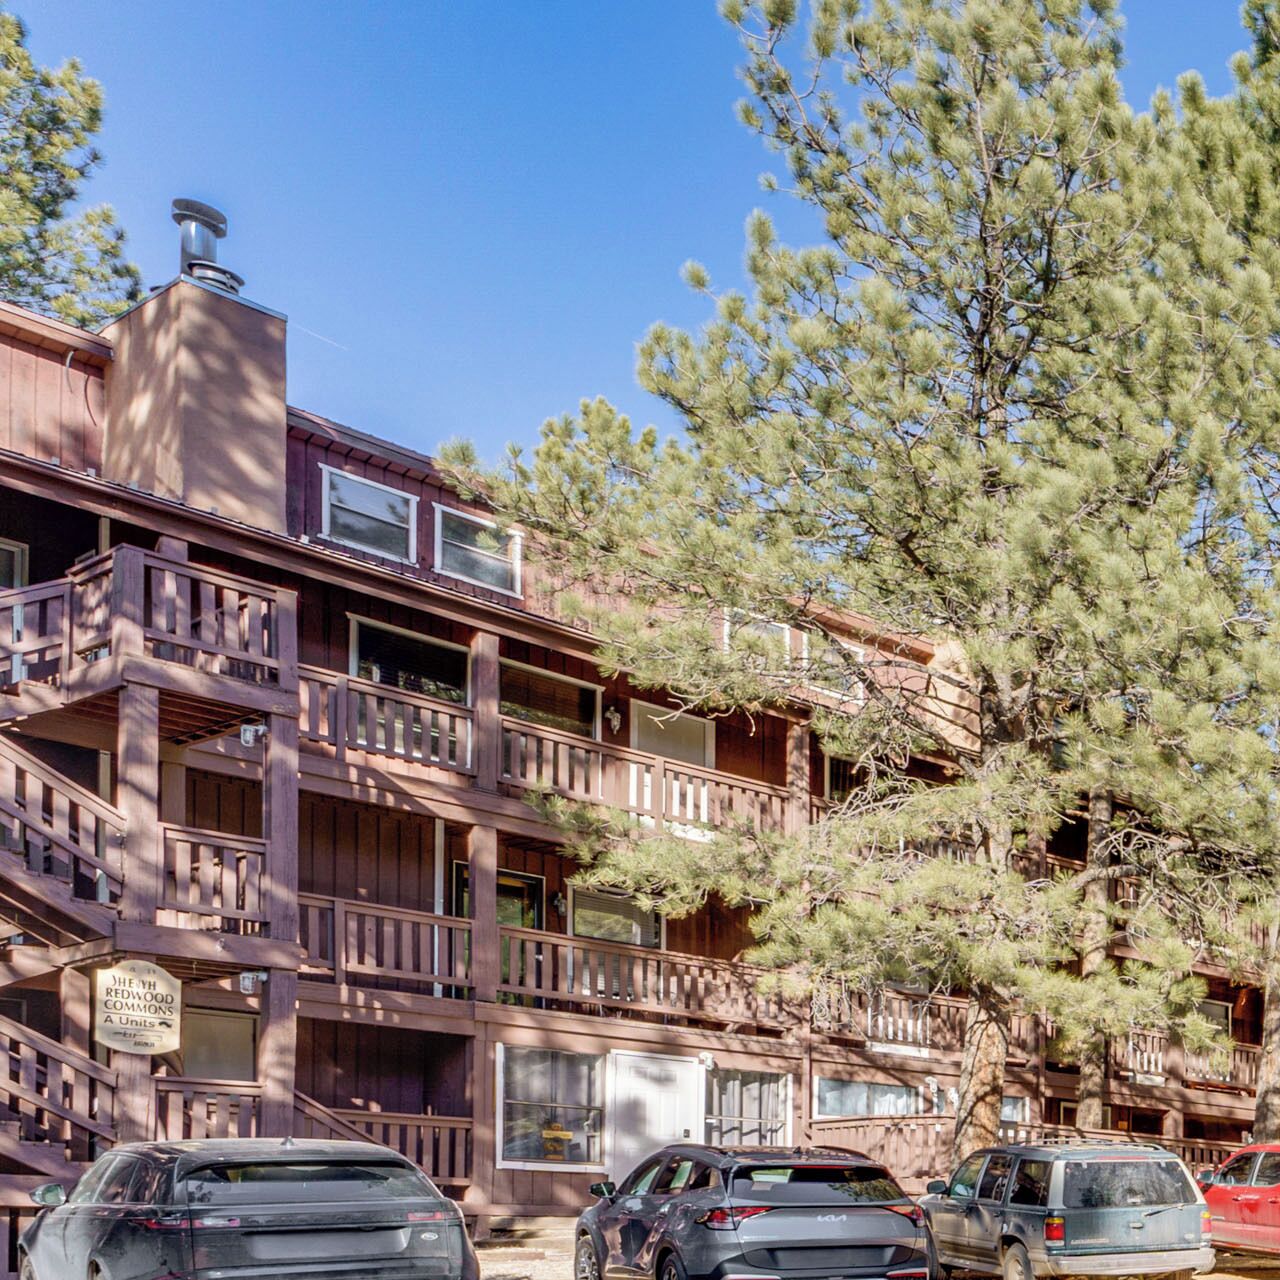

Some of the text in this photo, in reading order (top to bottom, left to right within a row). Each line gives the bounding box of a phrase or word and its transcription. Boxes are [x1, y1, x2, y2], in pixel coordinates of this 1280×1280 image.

[105, 987, 174, 1004] REDWOOD
[104, 999, 173, 1016] COMMONS
[104, 1015, 155, 1028] A Units
